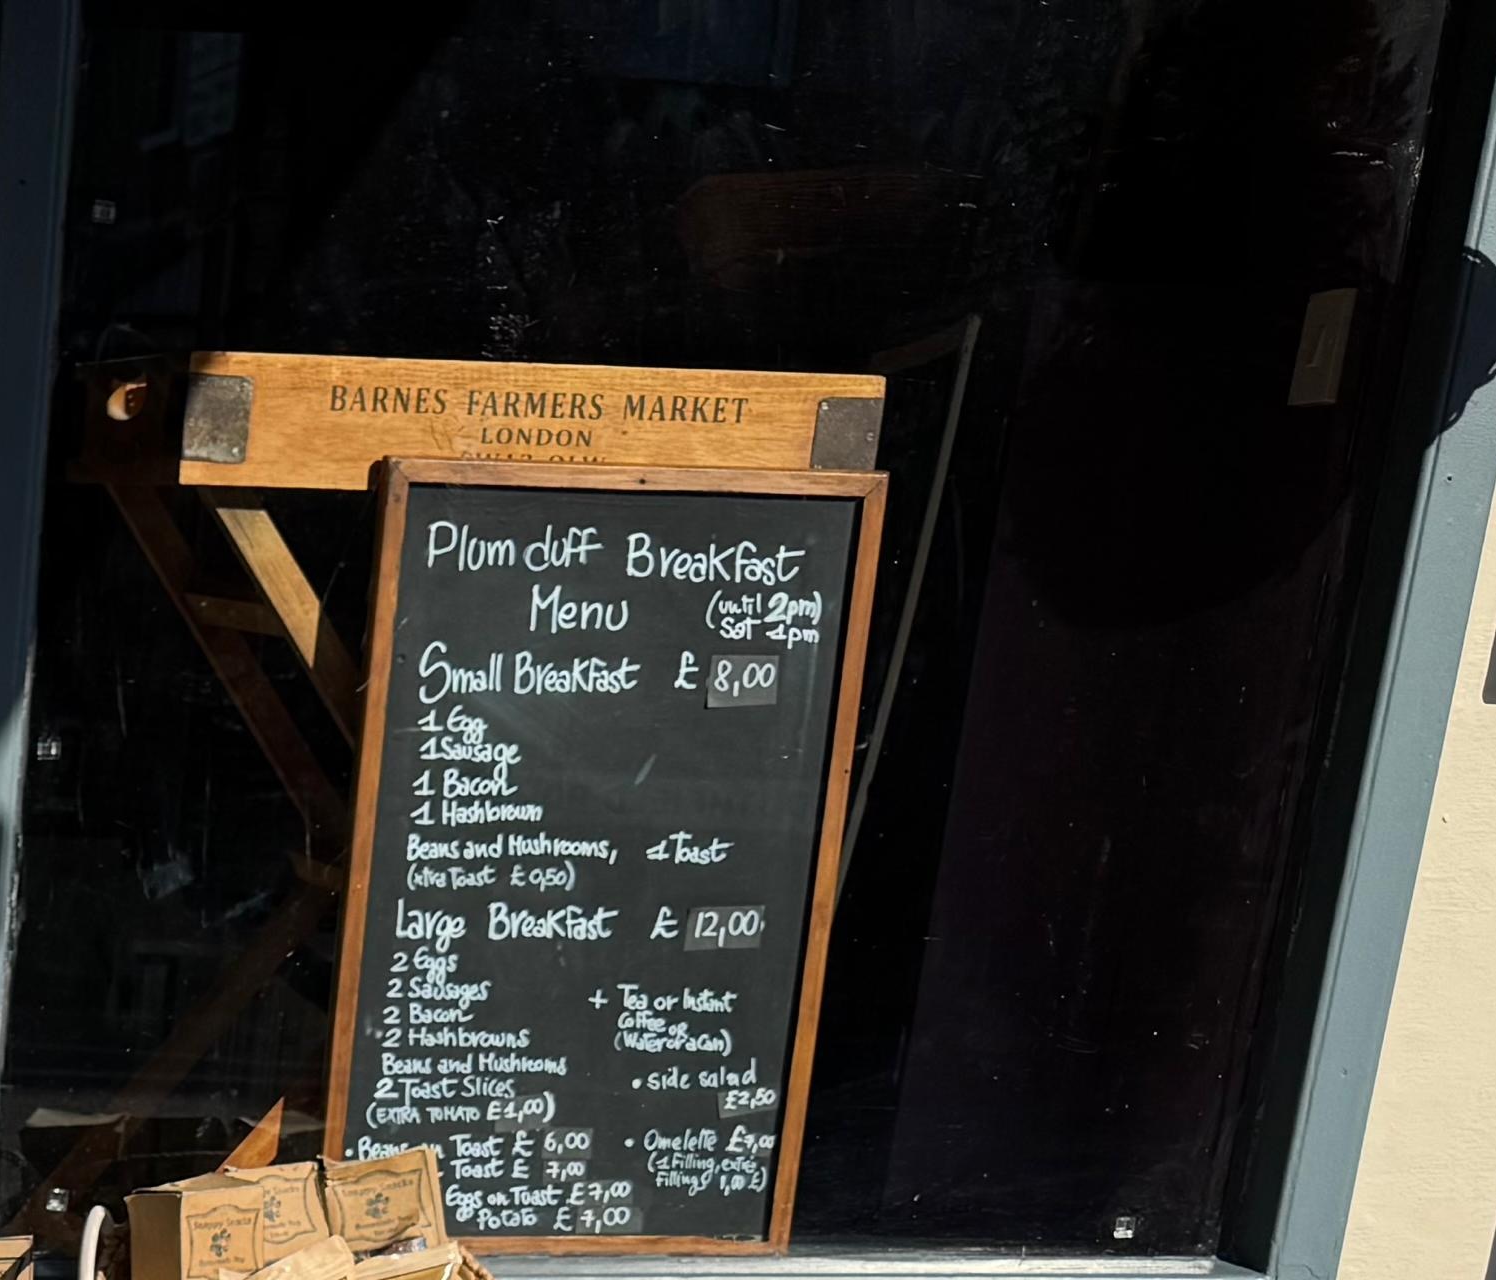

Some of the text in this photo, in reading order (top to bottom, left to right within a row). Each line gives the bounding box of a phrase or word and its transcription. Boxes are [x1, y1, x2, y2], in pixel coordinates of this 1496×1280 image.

[329, 384, 750, 424] BARNES FARMERS MARKET
[480, 426, 593, 448] LONDON
[427, 521, 806, 587] Plum duff Breakfast
[529, 584, 629, 634] Menu
[719, 617, 821, 650] Sat 1pm
[418, 640, 641, 706] Small Breakfast
[446, 704, 489, 744] Egg
[442, 766, 519, 799] Bacon
[441, 800, 545, 827] Hashbrown
[406, 832, 619, 866] Beans and Mushrooms,
[670, 831, 735, 865] Toast
[395, 898, 620, 954] Large Breakfast
[412, 949, 459, 984] Eggs
[408, 979, 493, 1013] Sausages
[616, 982, 739, 1013] Tea or Instant
[409, 1004, 476, 1024] Bacon
[617, 1010, 666, 1032] Coffee
[407, 1027, 532, 1050] Hashbrowns
[382, 1053, 569, 1077] Beans and Mushrooms
[646, 1056, 758, 1090] side salad
[400, 1075, 517, 1106] Toast Slices
[425, 1106, 482, 1124] TOMATO
[450, 1132, 504, 1157] Toast
[450, 1158, 505, 1180] Toast
[445, 1185, 563, 1222] Eggs on Toast
[476, 1209, 537, 1230] Potato
